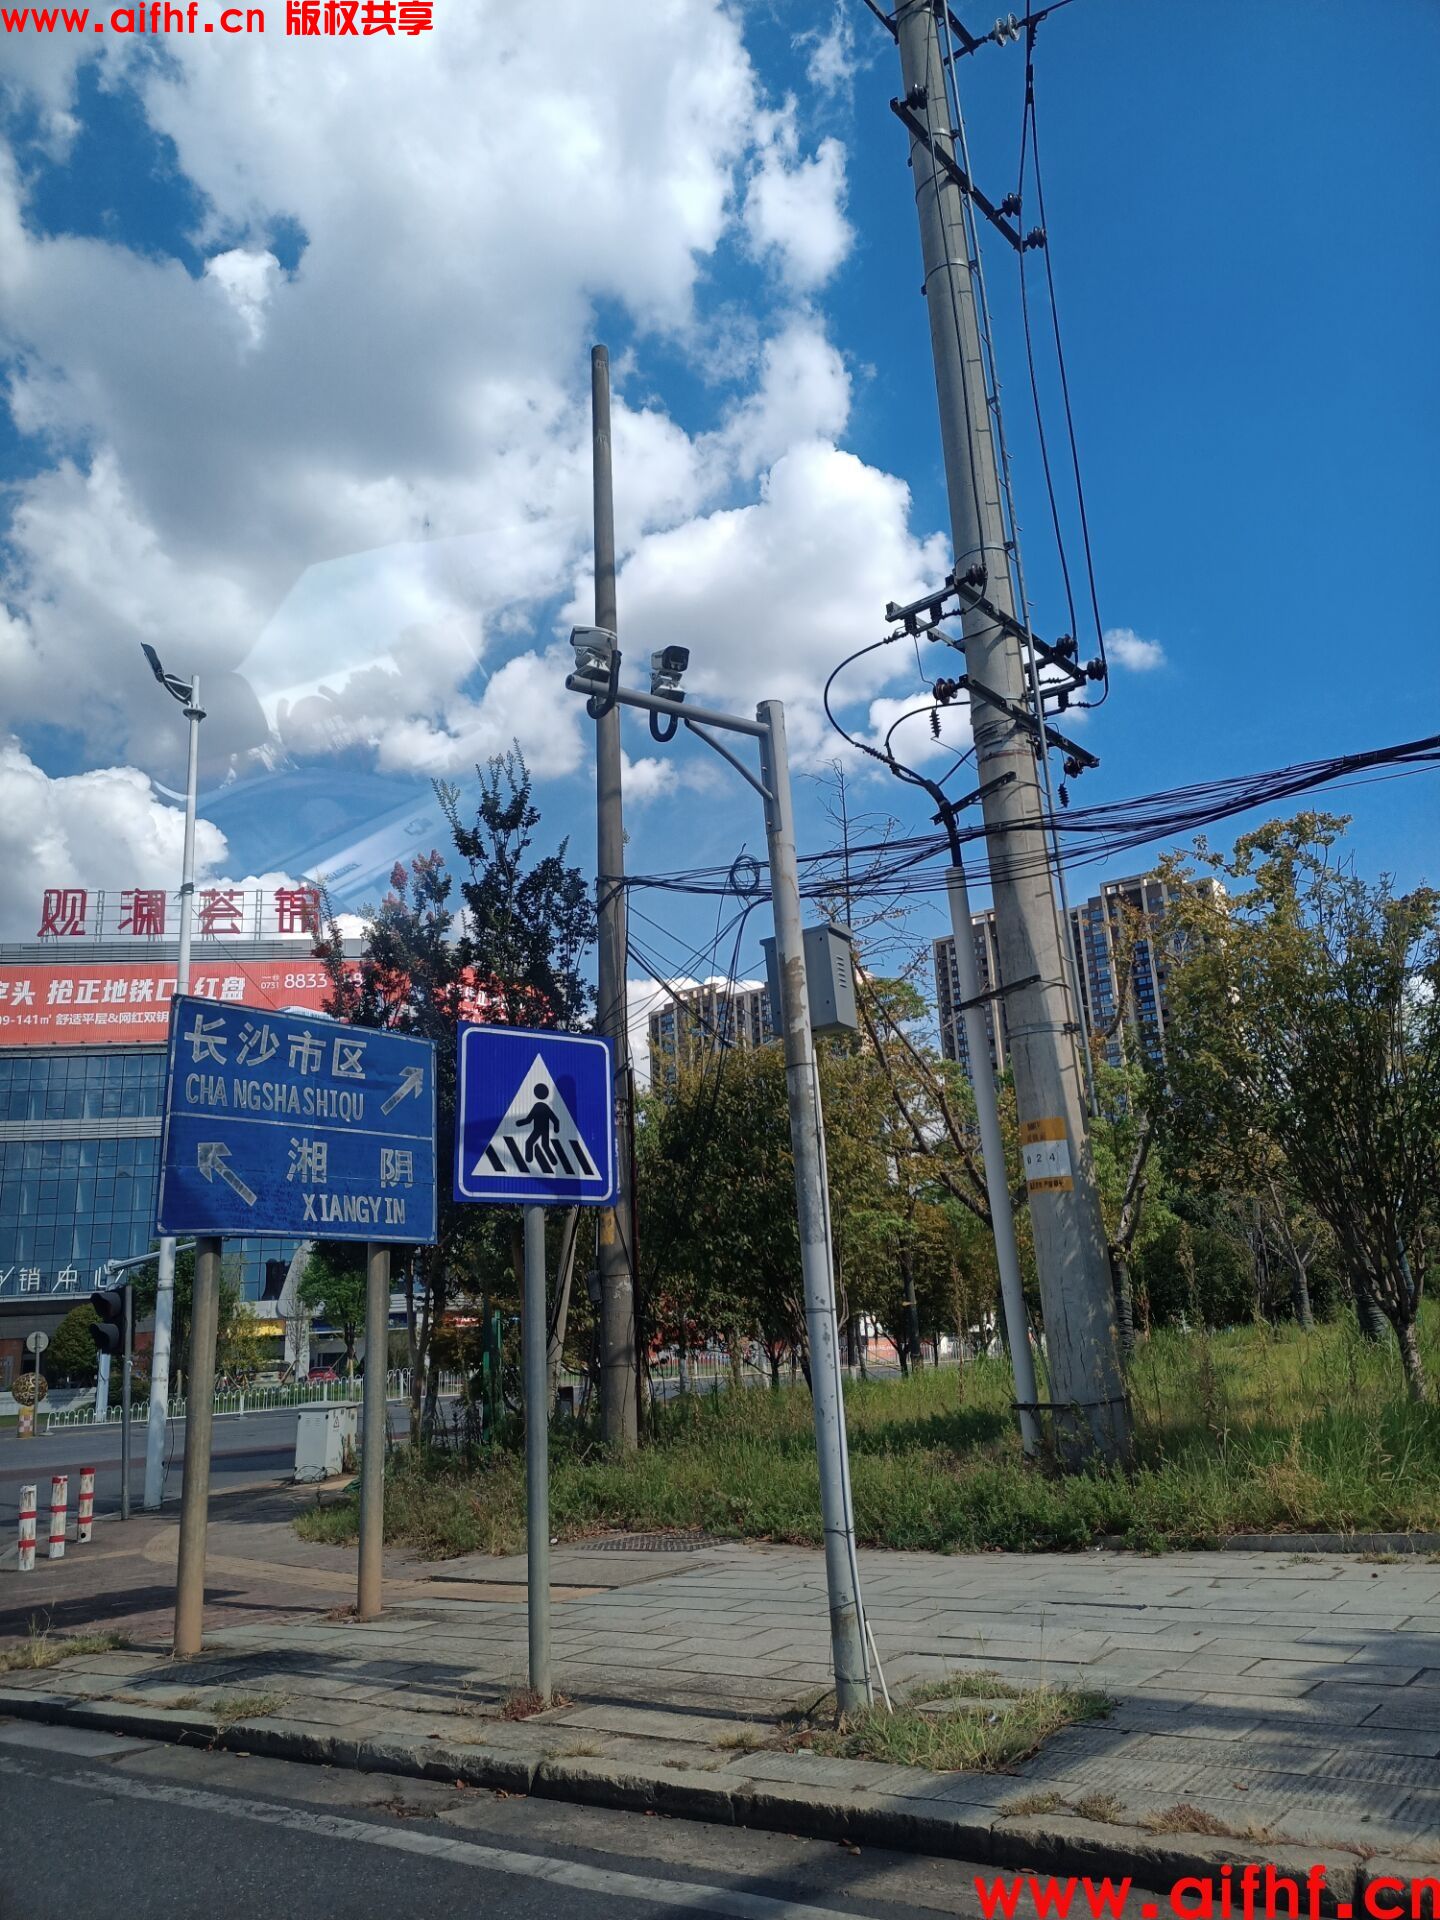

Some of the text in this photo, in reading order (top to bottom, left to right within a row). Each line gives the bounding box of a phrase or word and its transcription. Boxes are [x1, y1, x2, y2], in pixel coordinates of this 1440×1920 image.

[284, 973, 328, 989] 8833
[184, 1014, 367, 1079] 长沙市区
[186, 1073, 364, 1121] CHANGSHASHIQU
[302, 1193, 405, 1224] XIANGYIN
